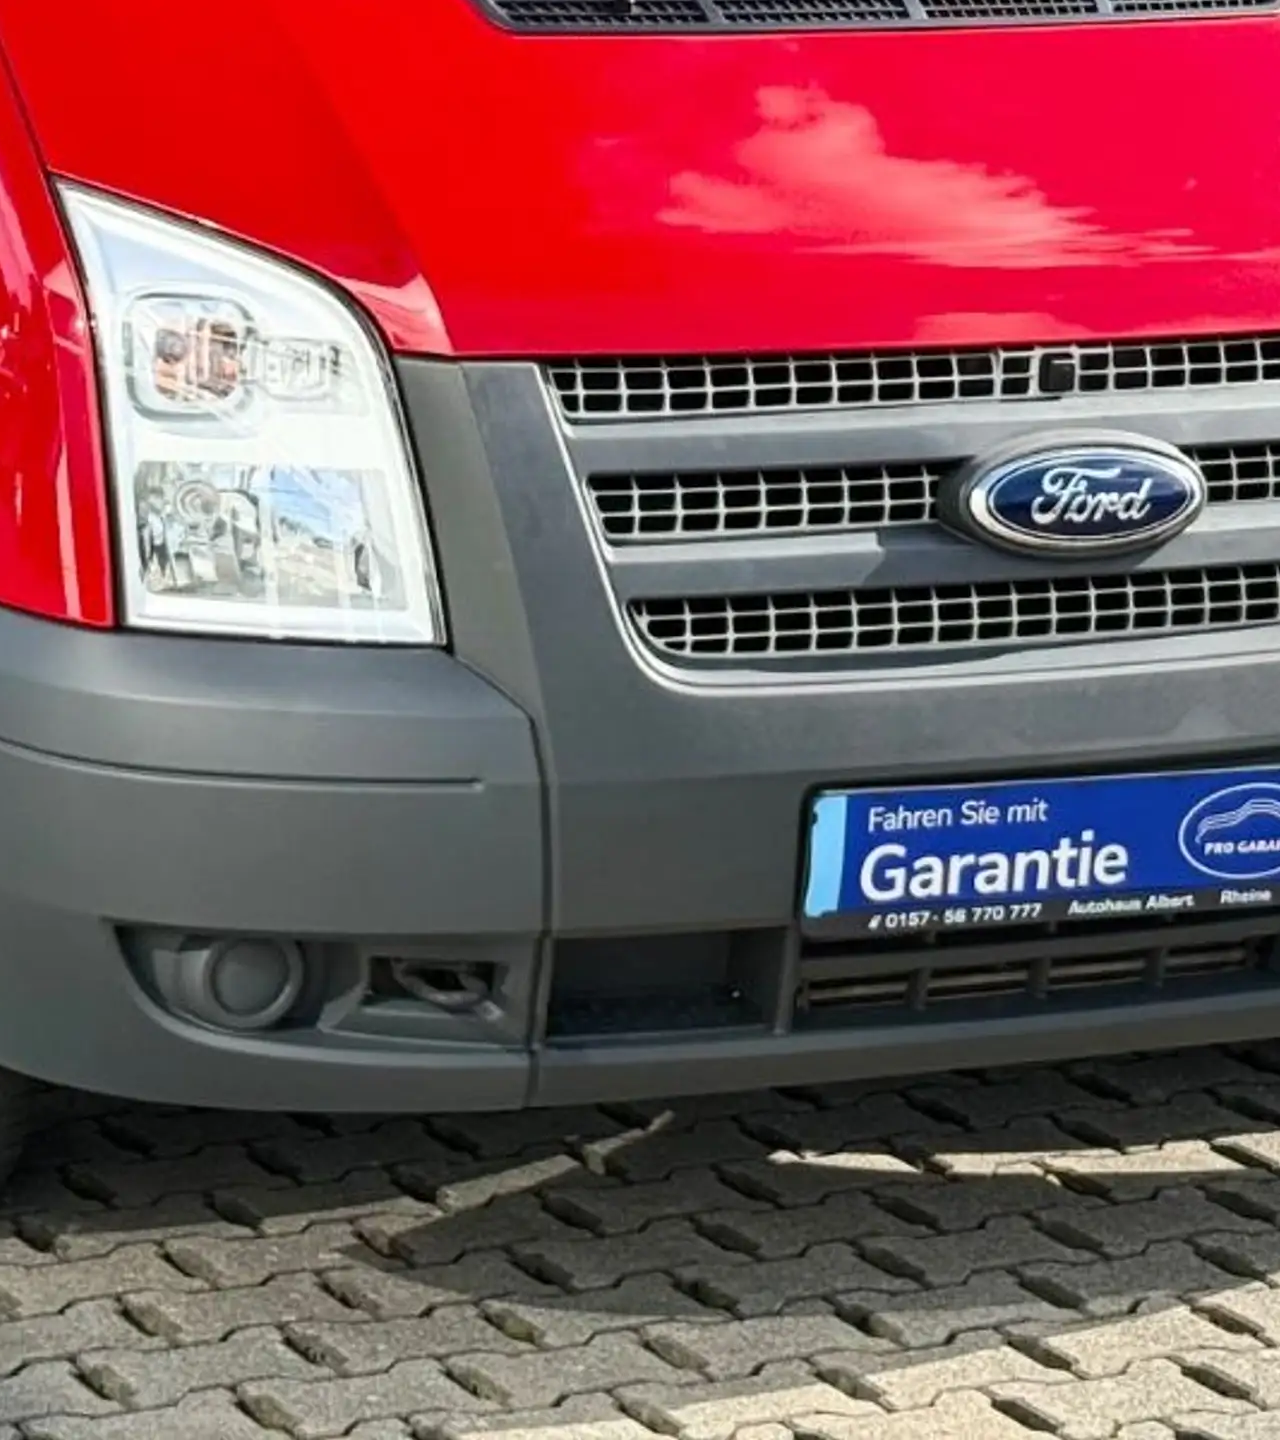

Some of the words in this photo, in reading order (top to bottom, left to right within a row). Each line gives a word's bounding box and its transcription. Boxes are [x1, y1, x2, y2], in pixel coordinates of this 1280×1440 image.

[1031, 467, 1152, 525] Ford
[868, 805, 954, 833] Fahren
[960, 799, 1001, 825] Sie
[1007, 797, 1049, 823] mit
[1203, 841, 1234, 856] PRO
[859, 829, 1129, 902] Garantie
[972, 905, 1005, 922] 770
[1010, 903, 1043, 919] 777
[1068, 899, 1141, 916] Autohaus
